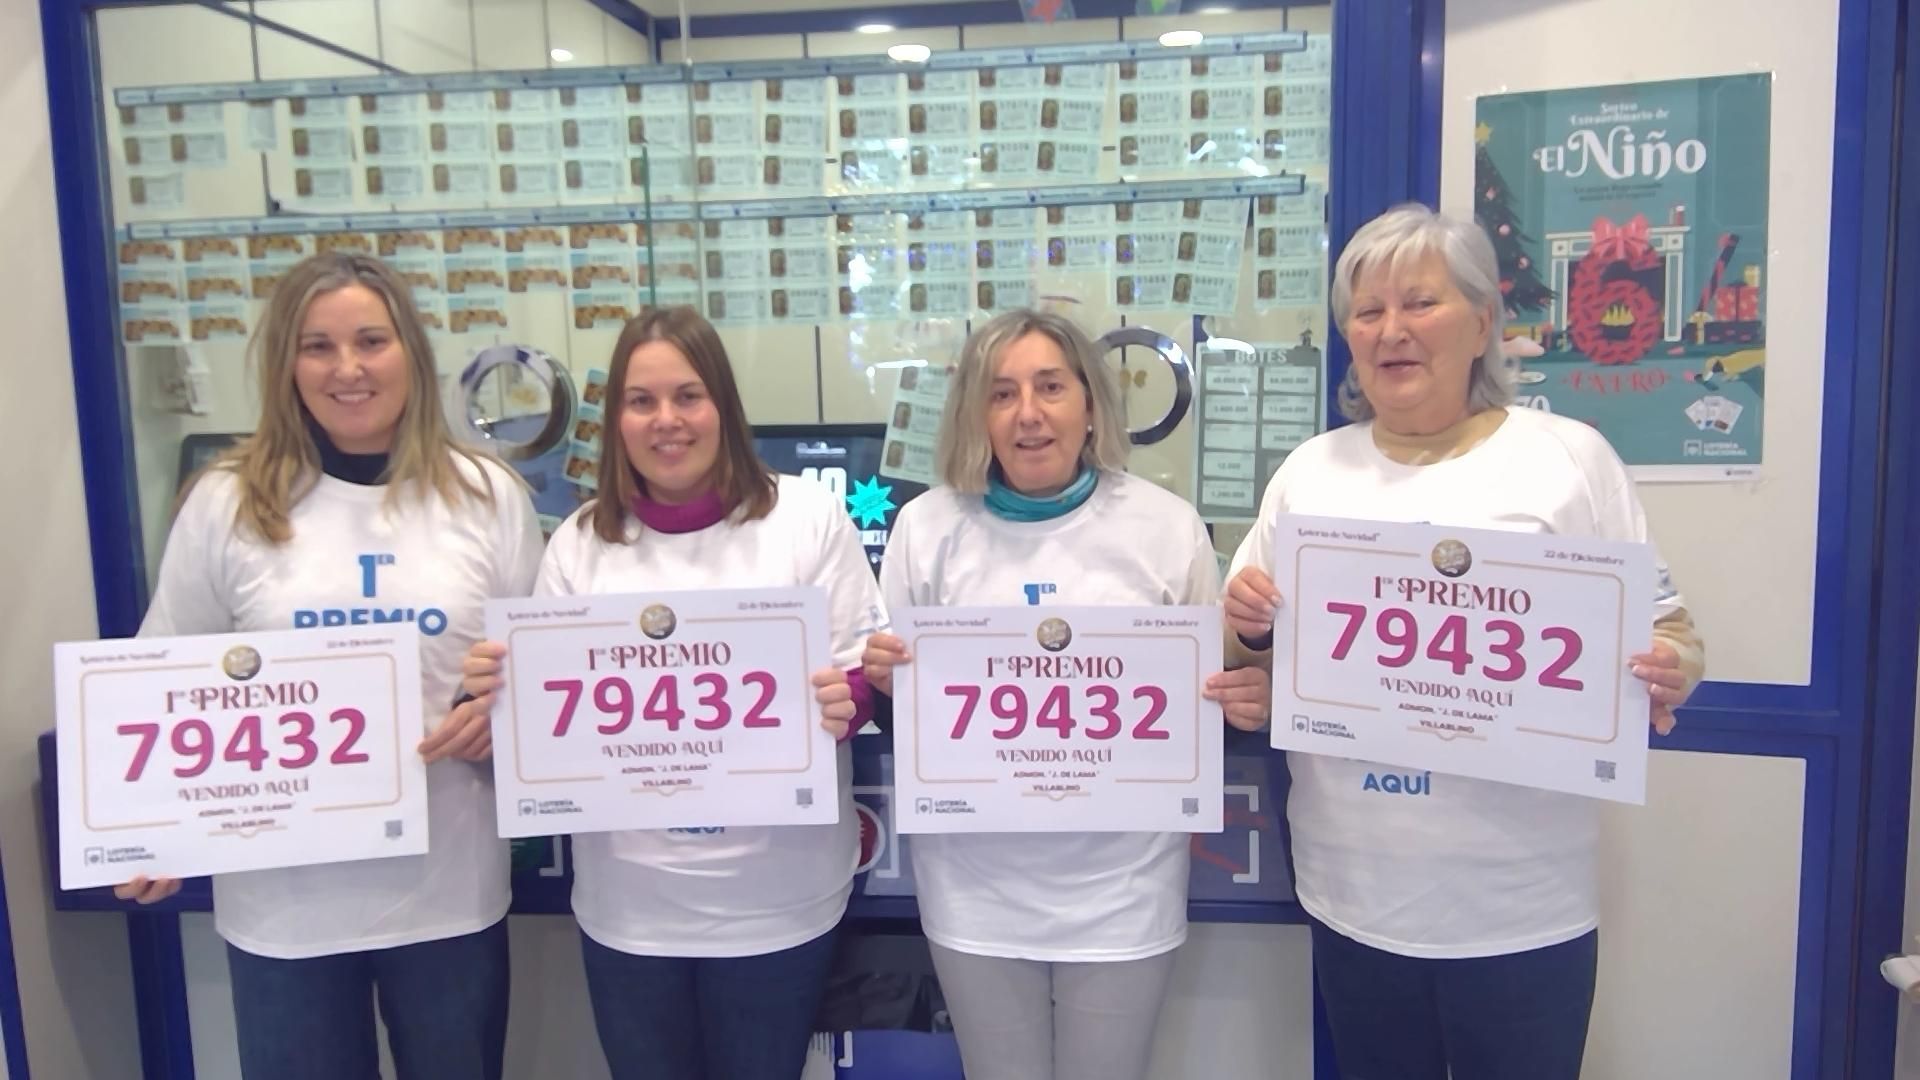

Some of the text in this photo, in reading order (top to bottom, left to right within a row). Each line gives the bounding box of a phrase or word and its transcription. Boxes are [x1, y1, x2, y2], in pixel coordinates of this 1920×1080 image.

[1565, 125, 1707, 180] Niño
[1397, 577, 1531, 615] PREMIO
[610, 641, 731, 669] PREMIO
[1326, 602, 1584, 692] 79432
[1007, 656, 1123, 679] PREMIO
[190, 680, 318, 712] PREMIO
[544, 671, 781, 737] 79432
[1380, 677, 1513, 708] VENDIDO AQUÍ
[944, 684, 1170, 741] 79432
[117, 708, 369, 782] 79432
[602, 738, 723, 758] VENDIDO AQUÍ
[996, 746, 1112, 765] VENDIDO AQUÍ
[179, 777, 310, 801] VENDIDO AQUÍ
[1363, 770, 1432, 795] AQUÍ
